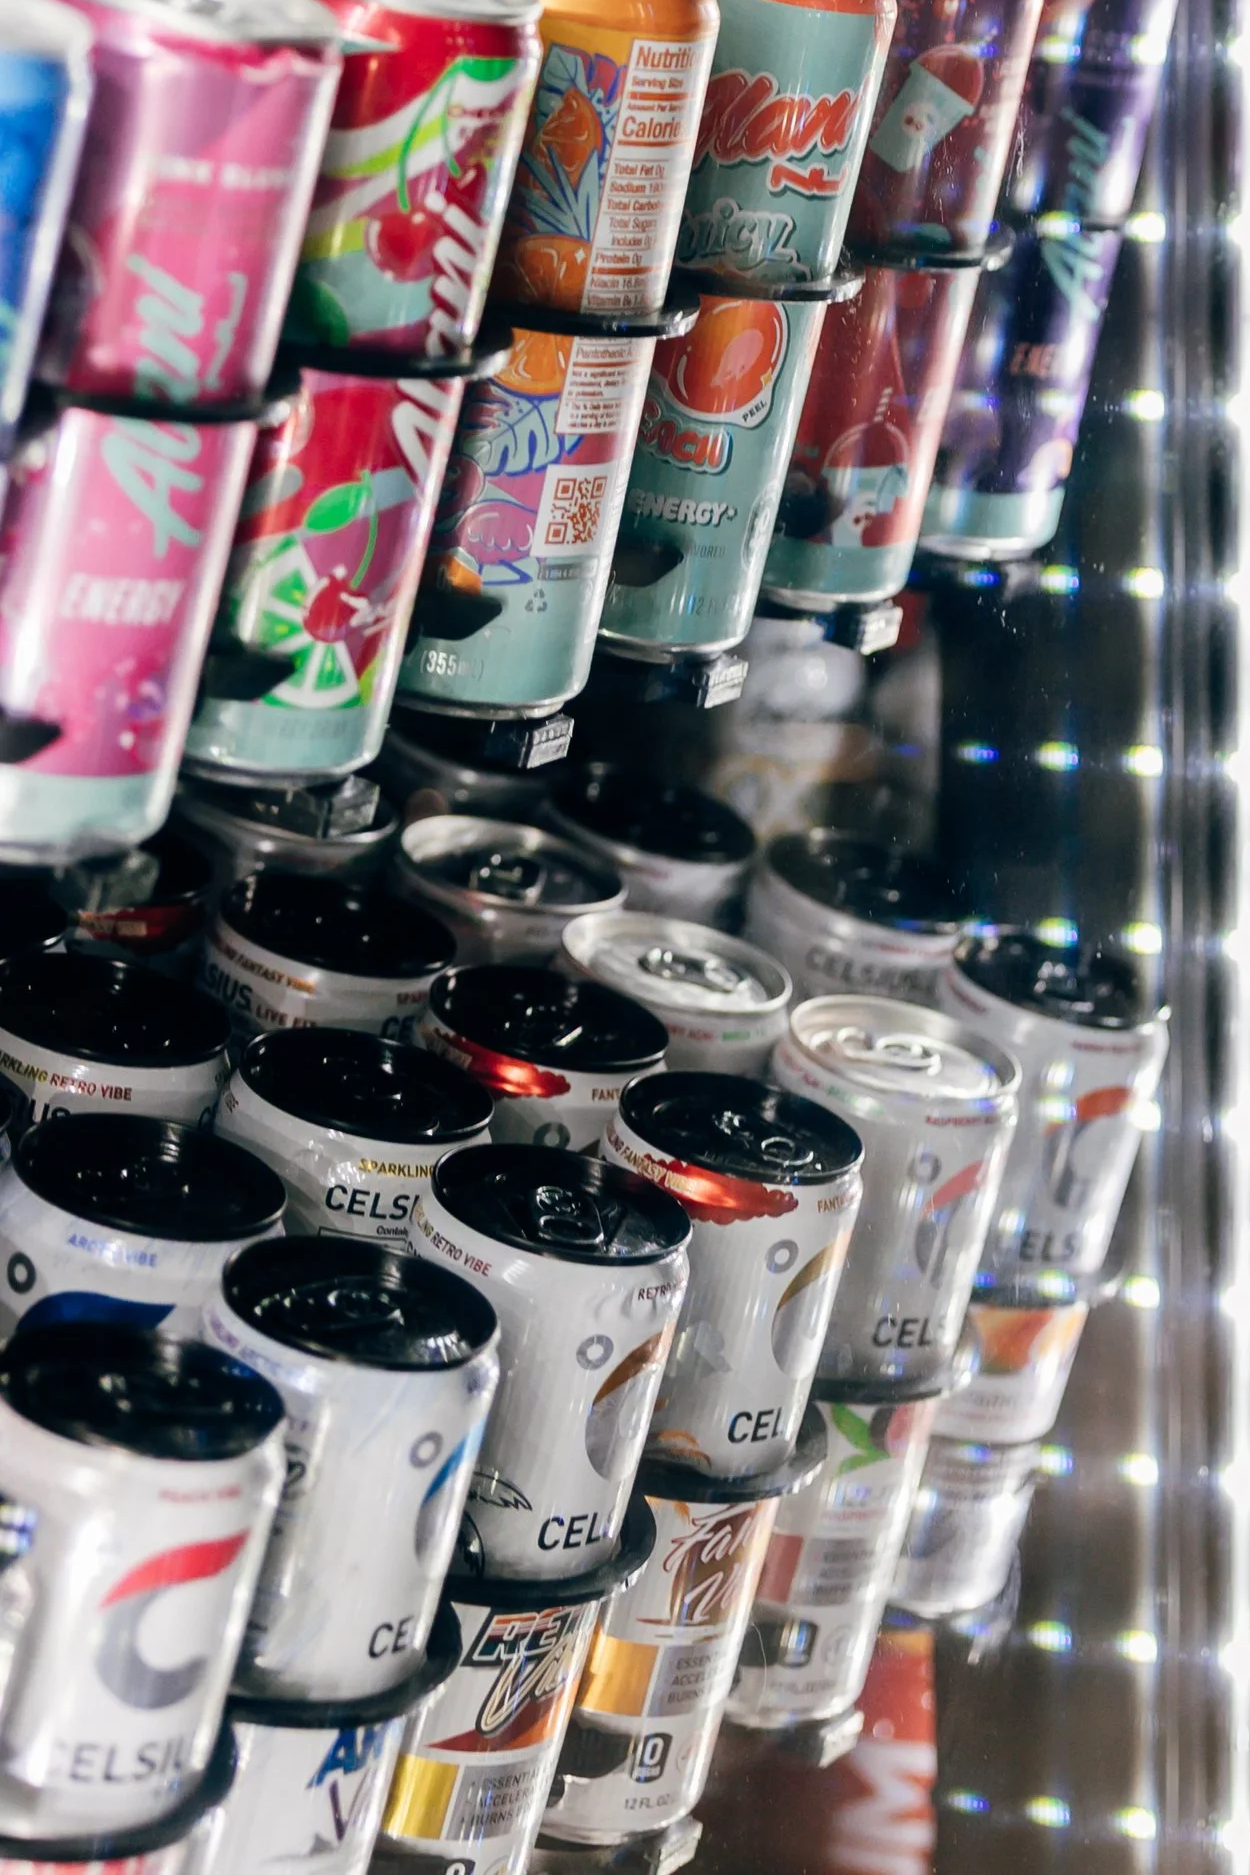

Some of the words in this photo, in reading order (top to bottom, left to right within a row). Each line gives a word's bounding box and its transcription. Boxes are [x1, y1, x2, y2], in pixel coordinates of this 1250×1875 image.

[614, 163, 637, 176] Total
[610, 181, 646, 194] Sodium
[607, 199, 630, 211] Total
[609, 216, 629, 228] Total
[596, 252, 630, 265] Protein
[742, 400, 767, 423] PEEL
[631, 487, 728, 528] ENERGY
[62, 571, 186, 626] ENERGY
[49, 1072, 97, 1096] RETRO
[100, 1084, 133, 1102] VIBE
[430, 1230, 463, 1262] RETRO
[463, 1253, 493, 1278] VIBE
